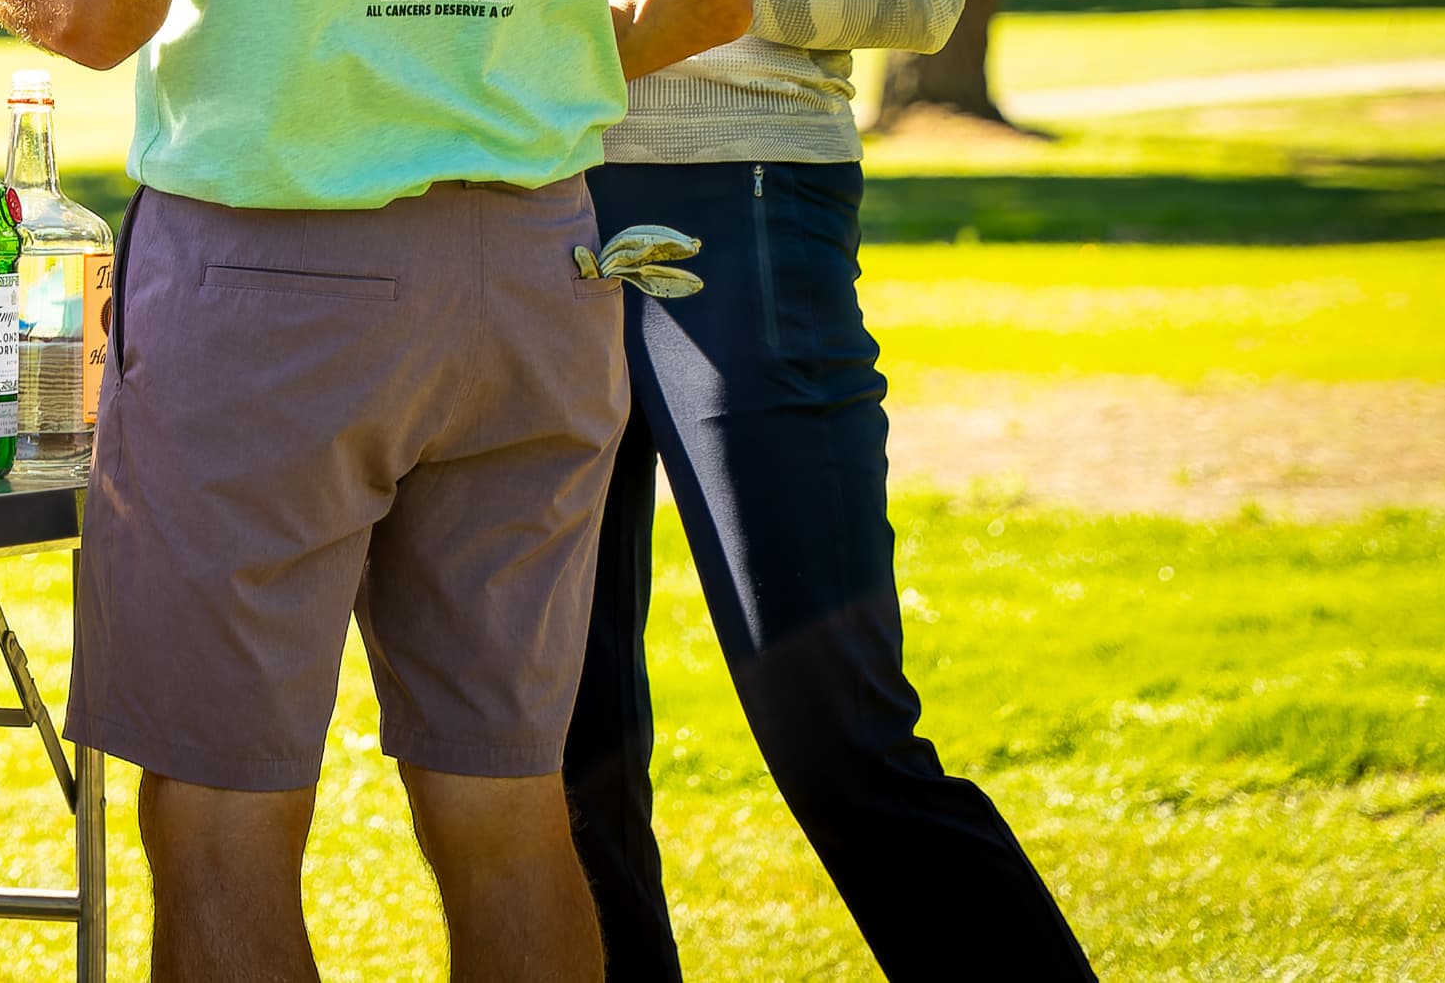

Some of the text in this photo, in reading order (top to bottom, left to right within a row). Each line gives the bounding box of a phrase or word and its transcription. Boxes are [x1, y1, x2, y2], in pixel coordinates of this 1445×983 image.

[366, 5, 383, 17] ALL
[386, 4, 431, 17] CANCERS
[435, 4, 486, 17] DESERVE
[489, 6, 498, 18] A
